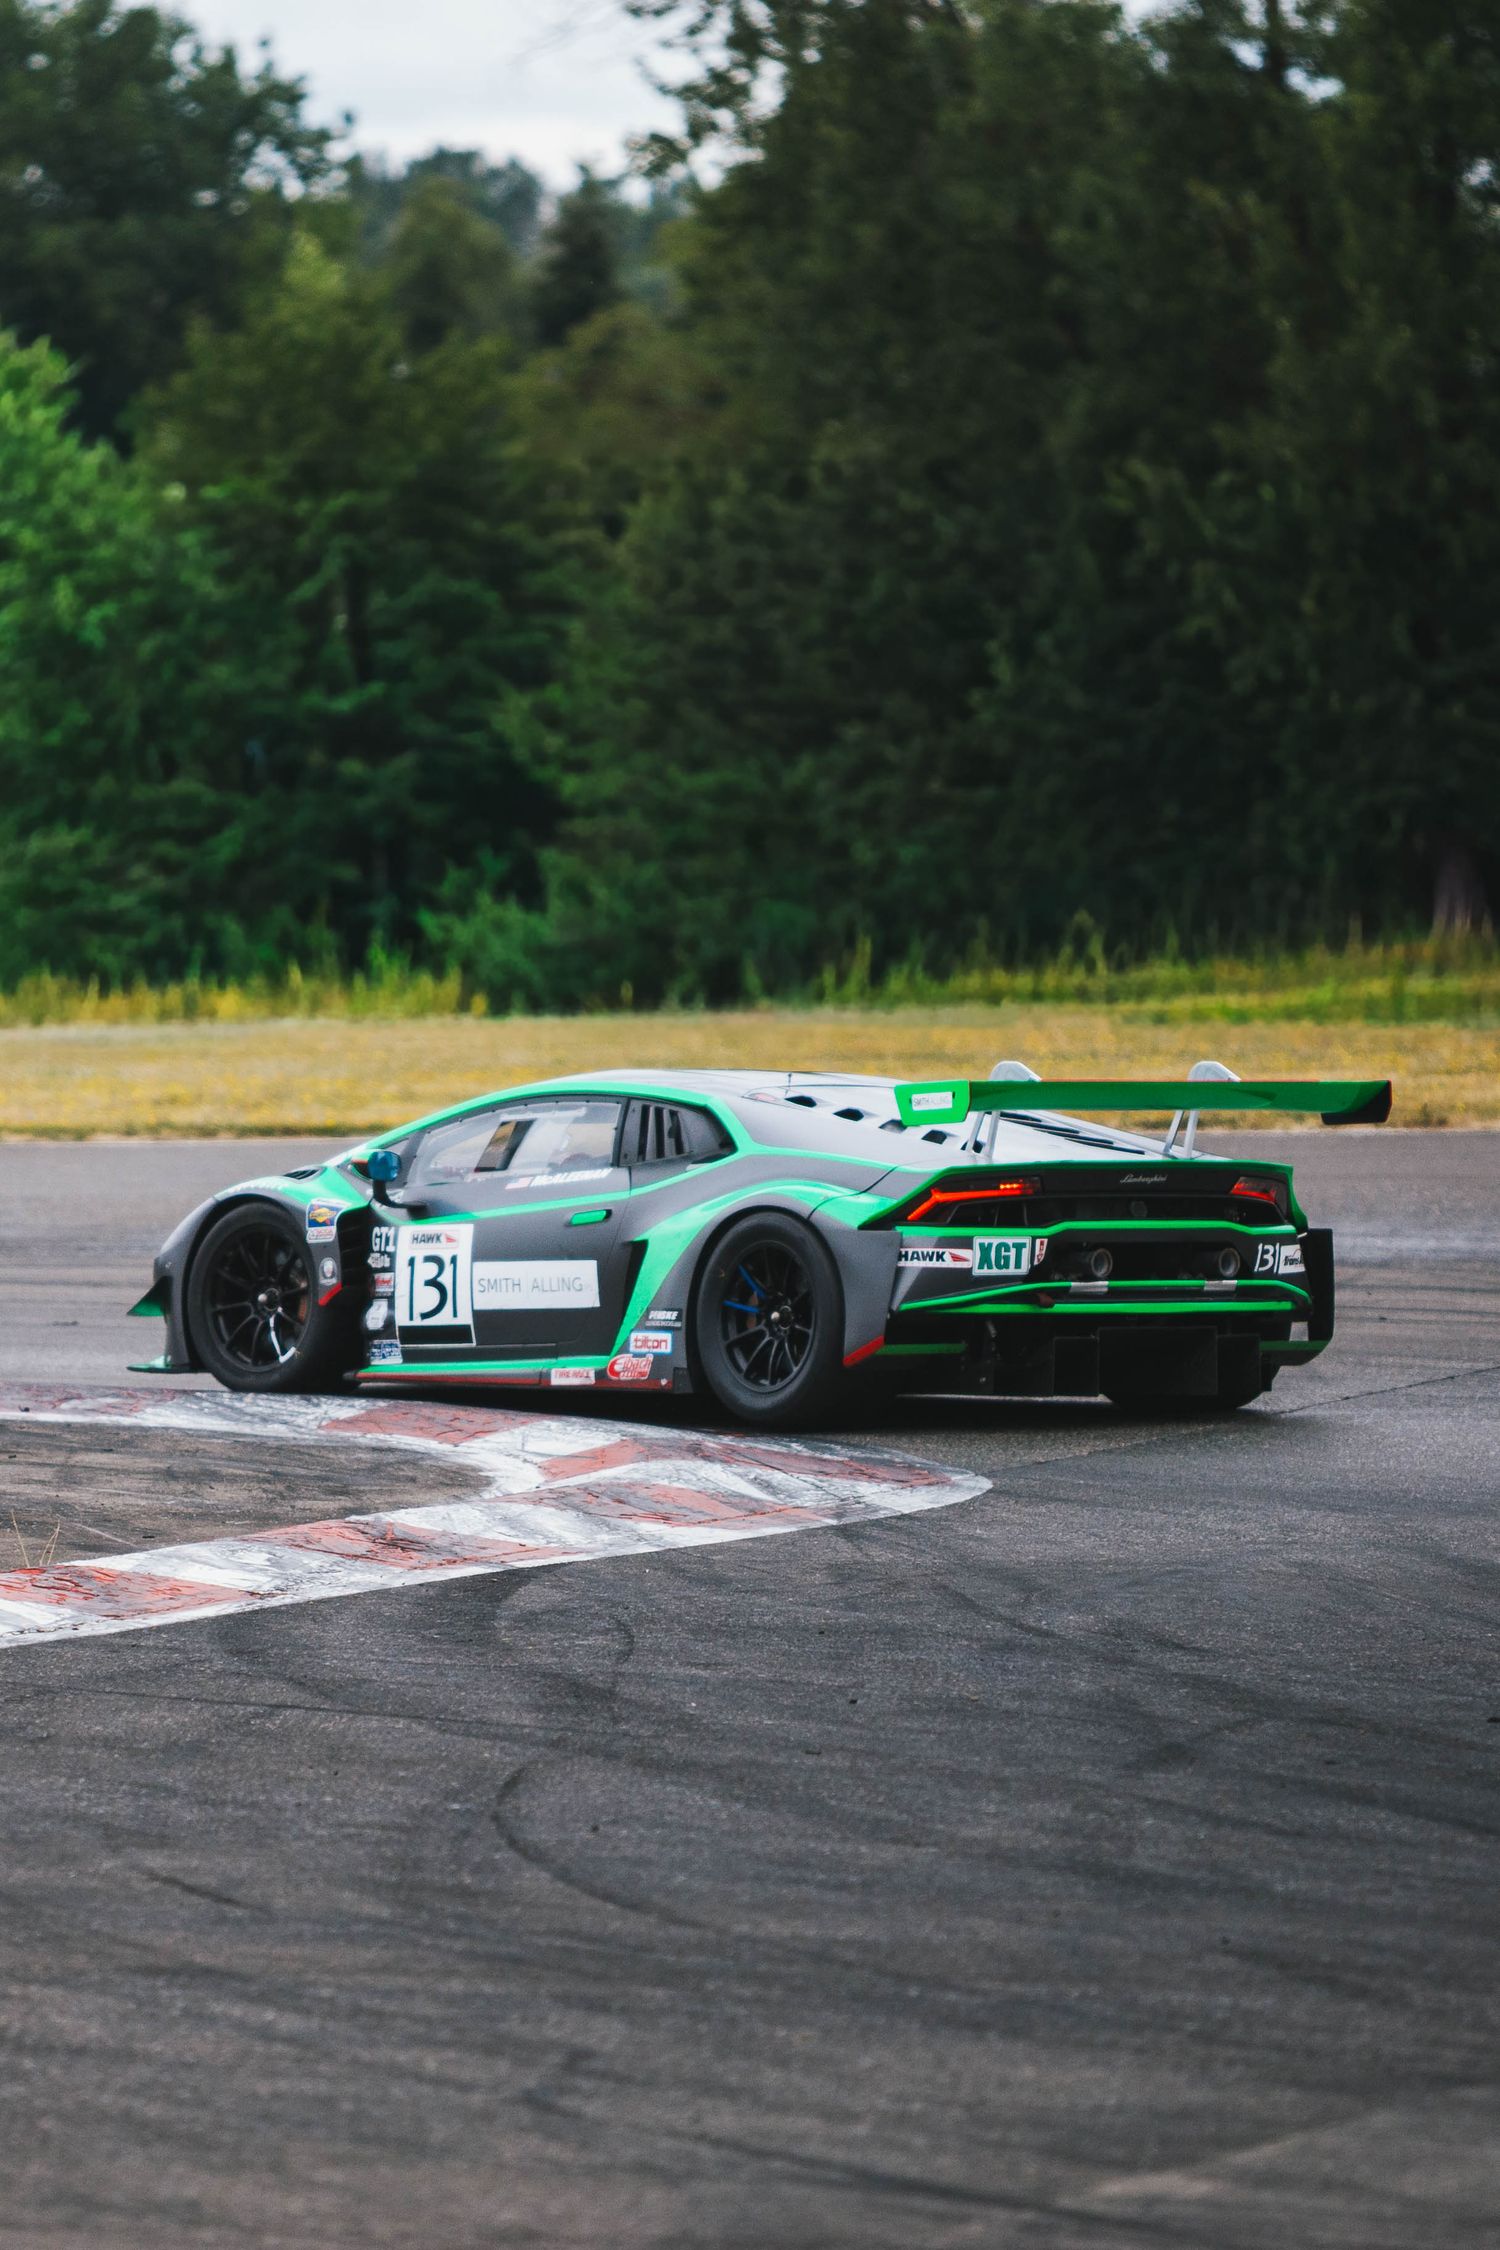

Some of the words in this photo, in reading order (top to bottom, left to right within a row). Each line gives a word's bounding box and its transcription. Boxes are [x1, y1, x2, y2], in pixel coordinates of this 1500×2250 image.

[372, 1226, 396, 1252] GT1
[412, 1233, 443, 1244] HAWK
[898, 1251, 946, 1262] HAWK
[977, 1241, 1027, 1270] XGT
[1254, 1242, 1280, 1273] 131
[407, 1254, 458, 1321] 131
[478, 1278, 521, 1293] SMITH
[531, 1277, 584, 1293] ALLING
